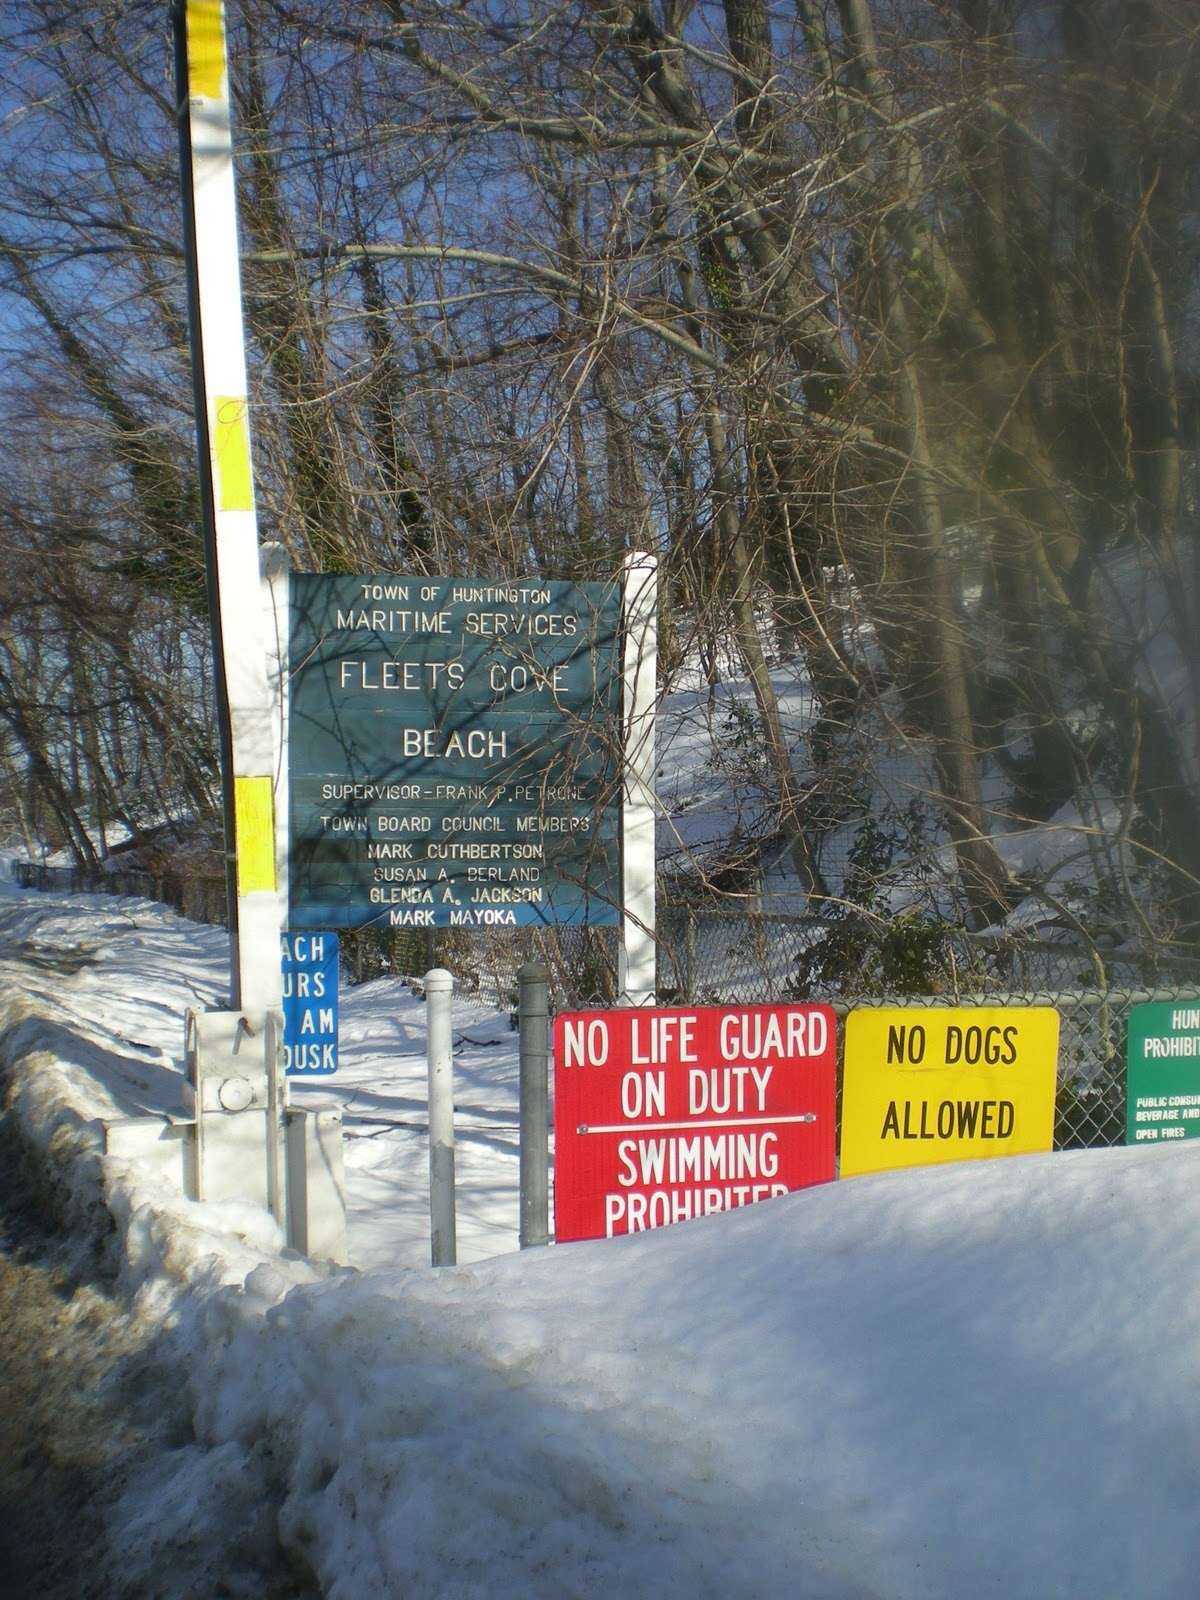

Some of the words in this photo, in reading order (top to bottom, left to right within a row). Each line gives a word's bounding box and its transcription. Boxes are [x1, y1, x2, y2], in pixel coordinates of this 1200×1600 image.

[361, 585, 409, 600] TOWN
[420, 586, 440, 601] OF
[453, 587, 550, 604] HUNTINGTON
[336, 610, 452, 633] MARITIME
[466, 612, 577, 636] SERVICES
[341, 661, 465, 690] FLEETS
[490, 665, 569, 692] COVE
[404, 729, 506, 759] BEACH
[321, 816, 367, 832] TOWN
[378, 816, 431, 832] BOARD
[442, 816, 505, 832] COUNCIL
[516, 816, 590, 832] MEMBERS
[368, 844, 413, 859] MARK
[427, 844, 542, 859] CUTHBERTSON
[374, 868, 427, 881] SUSAN
[438, 868, 455, 884] A.
[468, 867, 540, 882] BERLAND
[370, 887, 434, 903] GLENDA
[442, 887, 461, 906] A.
[471, 887, 542, 903] JACKSON
[390, 910, 435, 926] MARK
[450, 909, 517, 925] MAYOKA
[301, 1008, 334, 1034] AM
[1172, 1009, 1200, 1030] HUN
[564, 1019, 609, 1068] NO
[631, 1016, 698, 1065] LIFE
[720, 1011, 828, 1061] GUARD
[887, 1025, 926, 1064] NO
[945, 1025, 1019, 1065] DOGS
[284, 1044, 335, 1070] DUSK
[621, 1071, 666, 1118] ON
[689, 1066, 774, 1115] DUTY
[1136, 1096, 1167, 1108] PUBLIC
[880, 1101, 1015, 1140] ALLOWED
[1136, 1109, 1179, 1122] BEVERAGE
[1182, 1108, 1200, 1119] AND
[1136, 1128, 1158, 1140] OPEN
[1161, 1127, 1185, 1138] FIRES
[618, 1132, 778, 1187] SWIMMING
[606, 1184, 790, 1239] PROHIBIT
